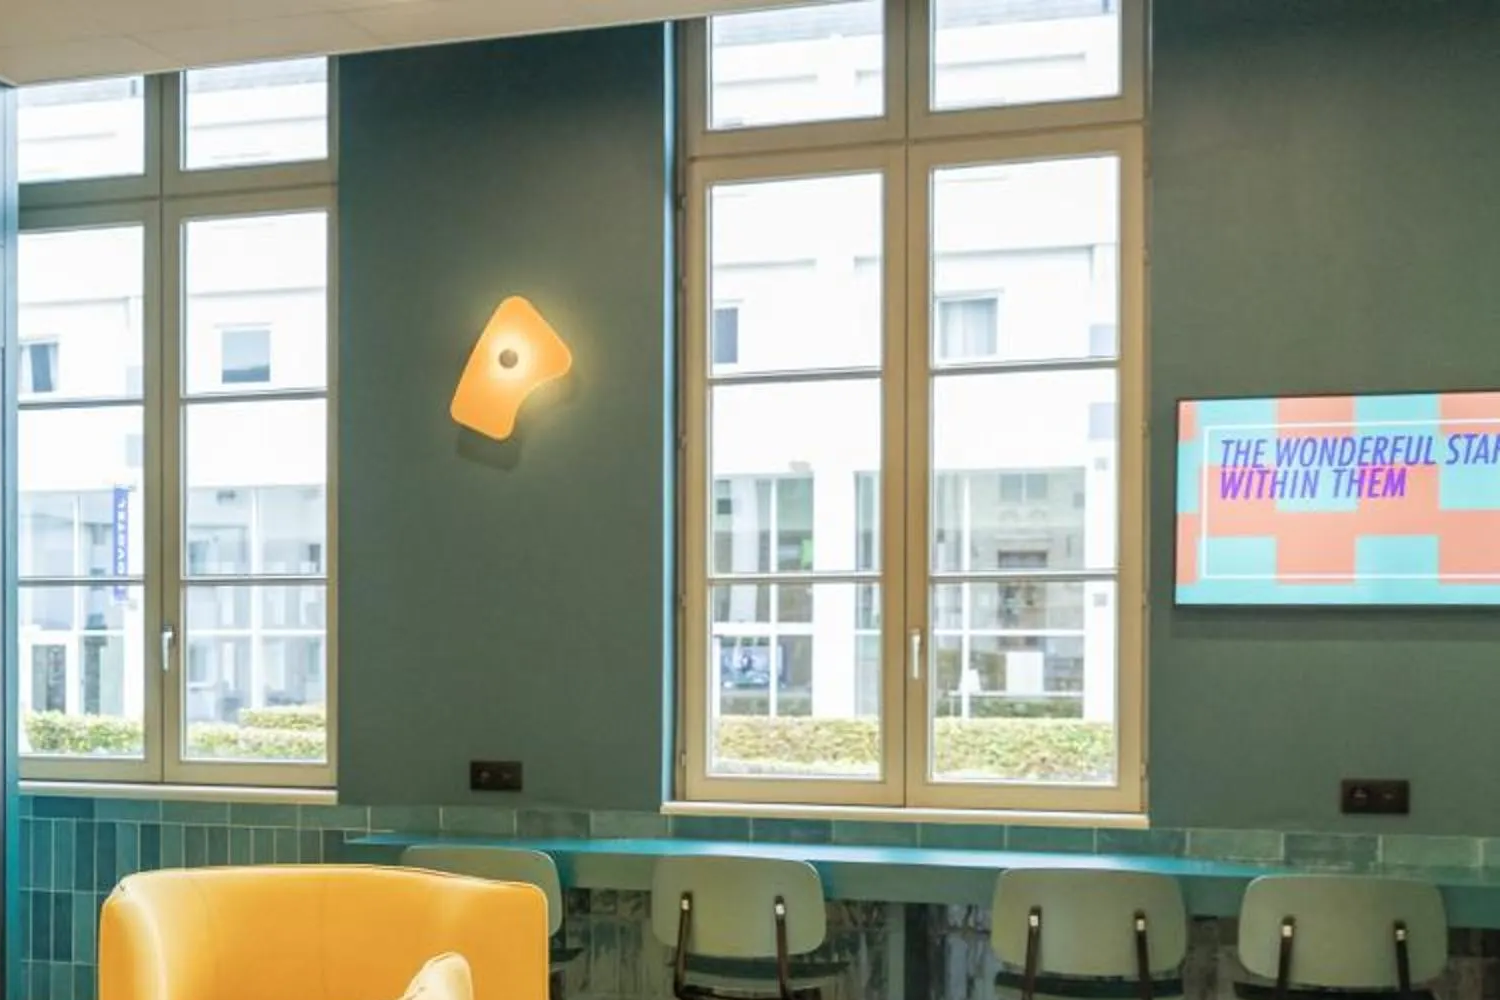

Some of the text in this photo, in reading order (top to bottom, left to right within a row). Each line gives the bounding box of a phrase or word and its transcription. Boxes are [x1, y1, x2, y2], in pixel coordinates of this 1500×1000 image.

[1221, 438, 1268, 468] THE
[1276, 434, 1437, 467] WONDERFUL
[1220, 467, 1407, 499] WITHIN THEM
